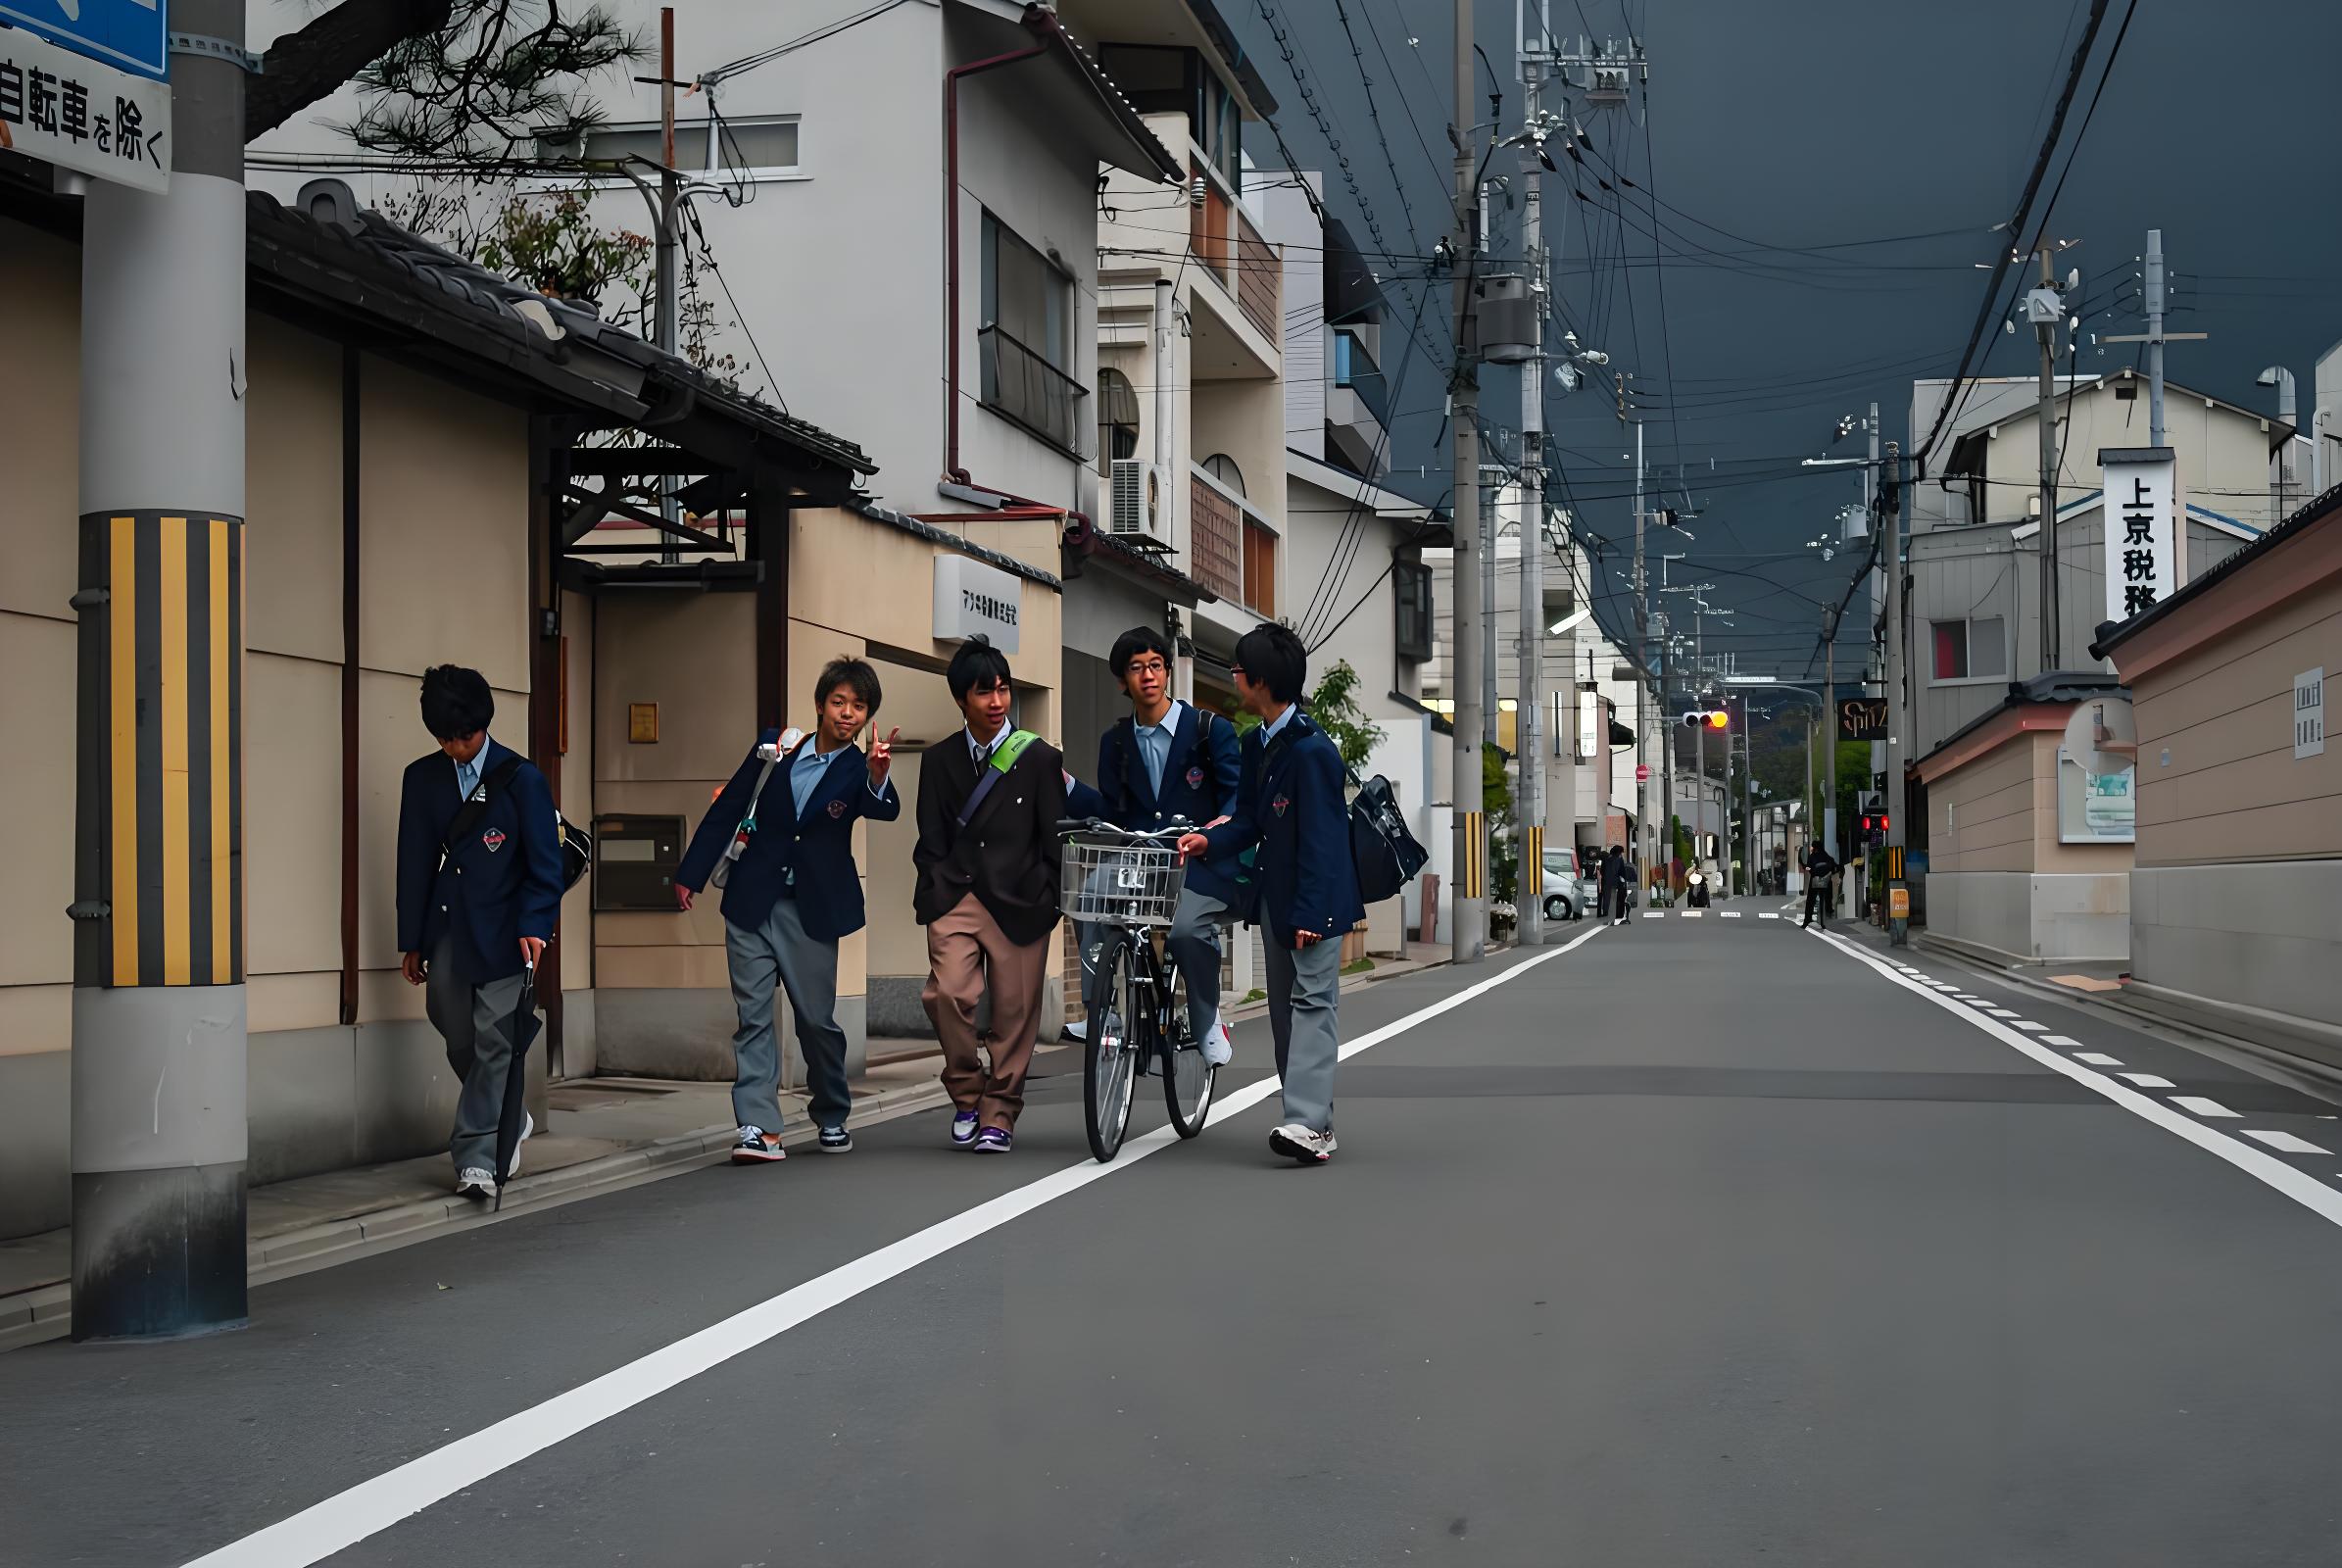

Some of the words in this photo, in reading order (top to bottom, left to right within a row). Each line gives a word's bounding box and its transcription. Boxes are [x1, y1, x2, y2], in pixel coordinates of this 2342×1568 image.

[0, 59, 163, 170] 自転車を除く
[2122, 477, 2157, 616] 上京税務
